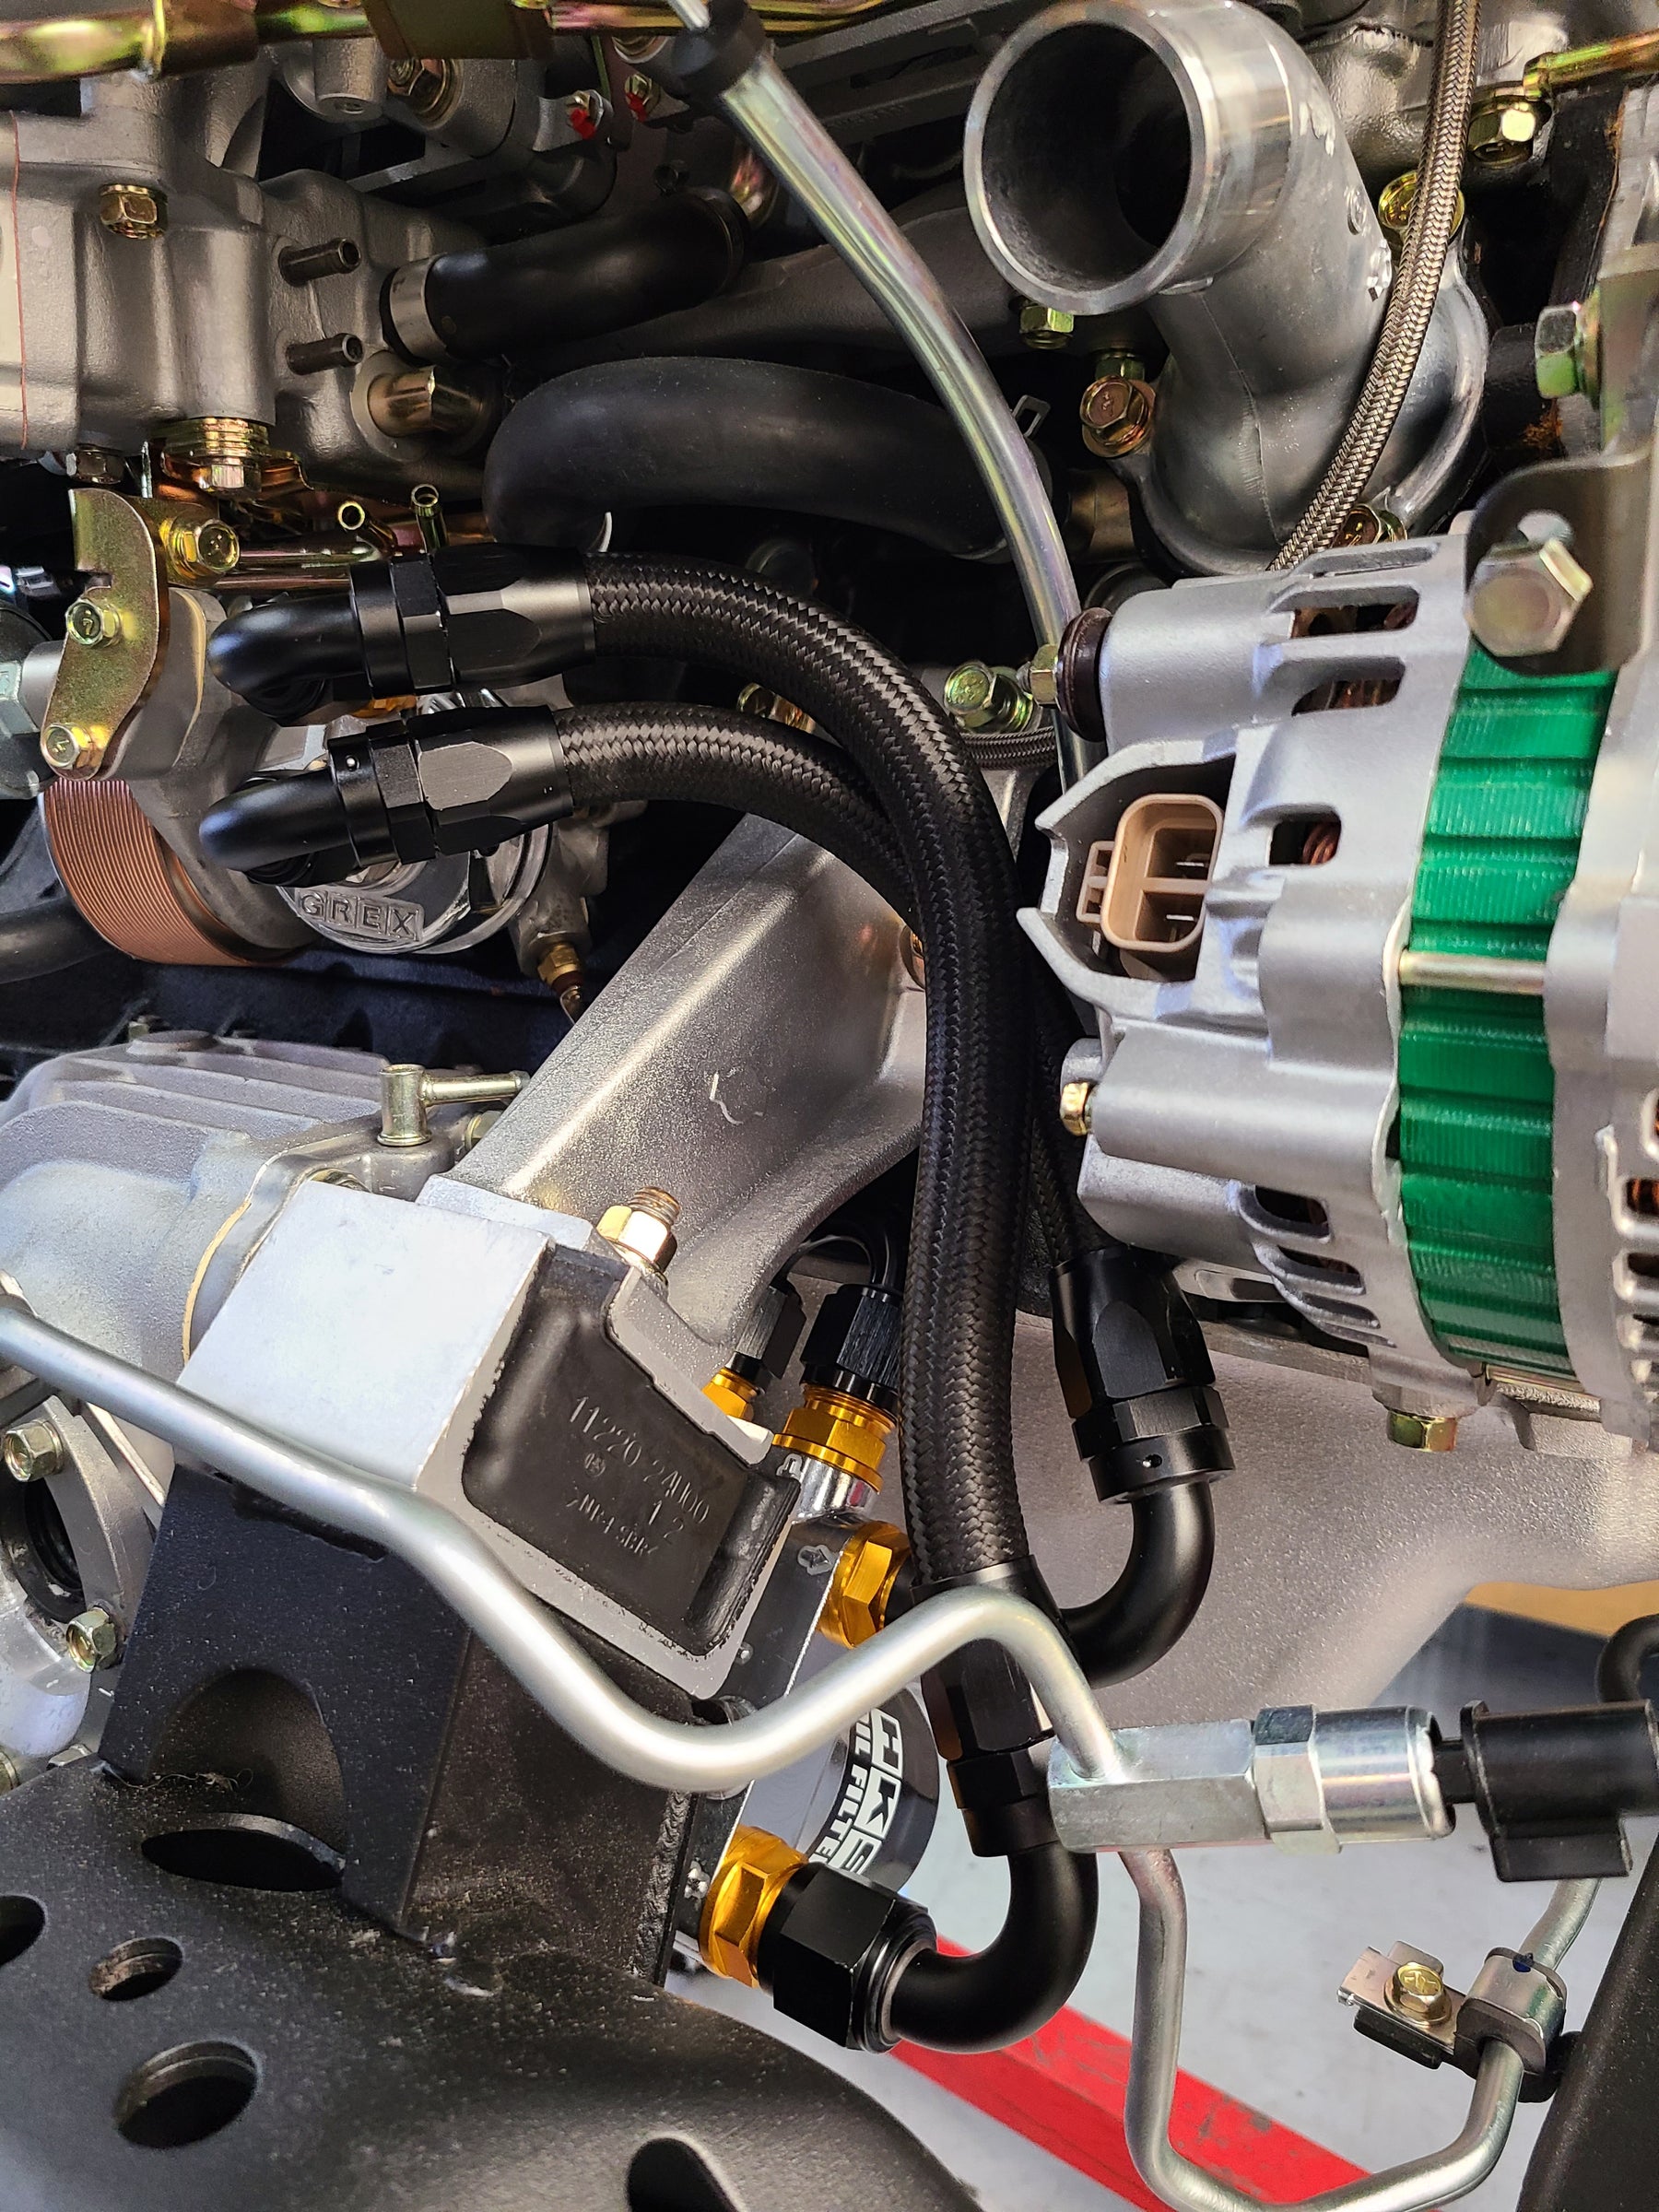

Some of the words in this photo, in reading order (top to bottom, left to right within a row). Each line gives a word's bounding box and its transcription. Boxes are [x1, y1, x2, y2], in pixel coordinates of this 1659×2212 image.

[300, 891, 418, 936] GREX
[569, 1395, 642, 1467] 11220
[828, 1708, 903, 1875] HKS
